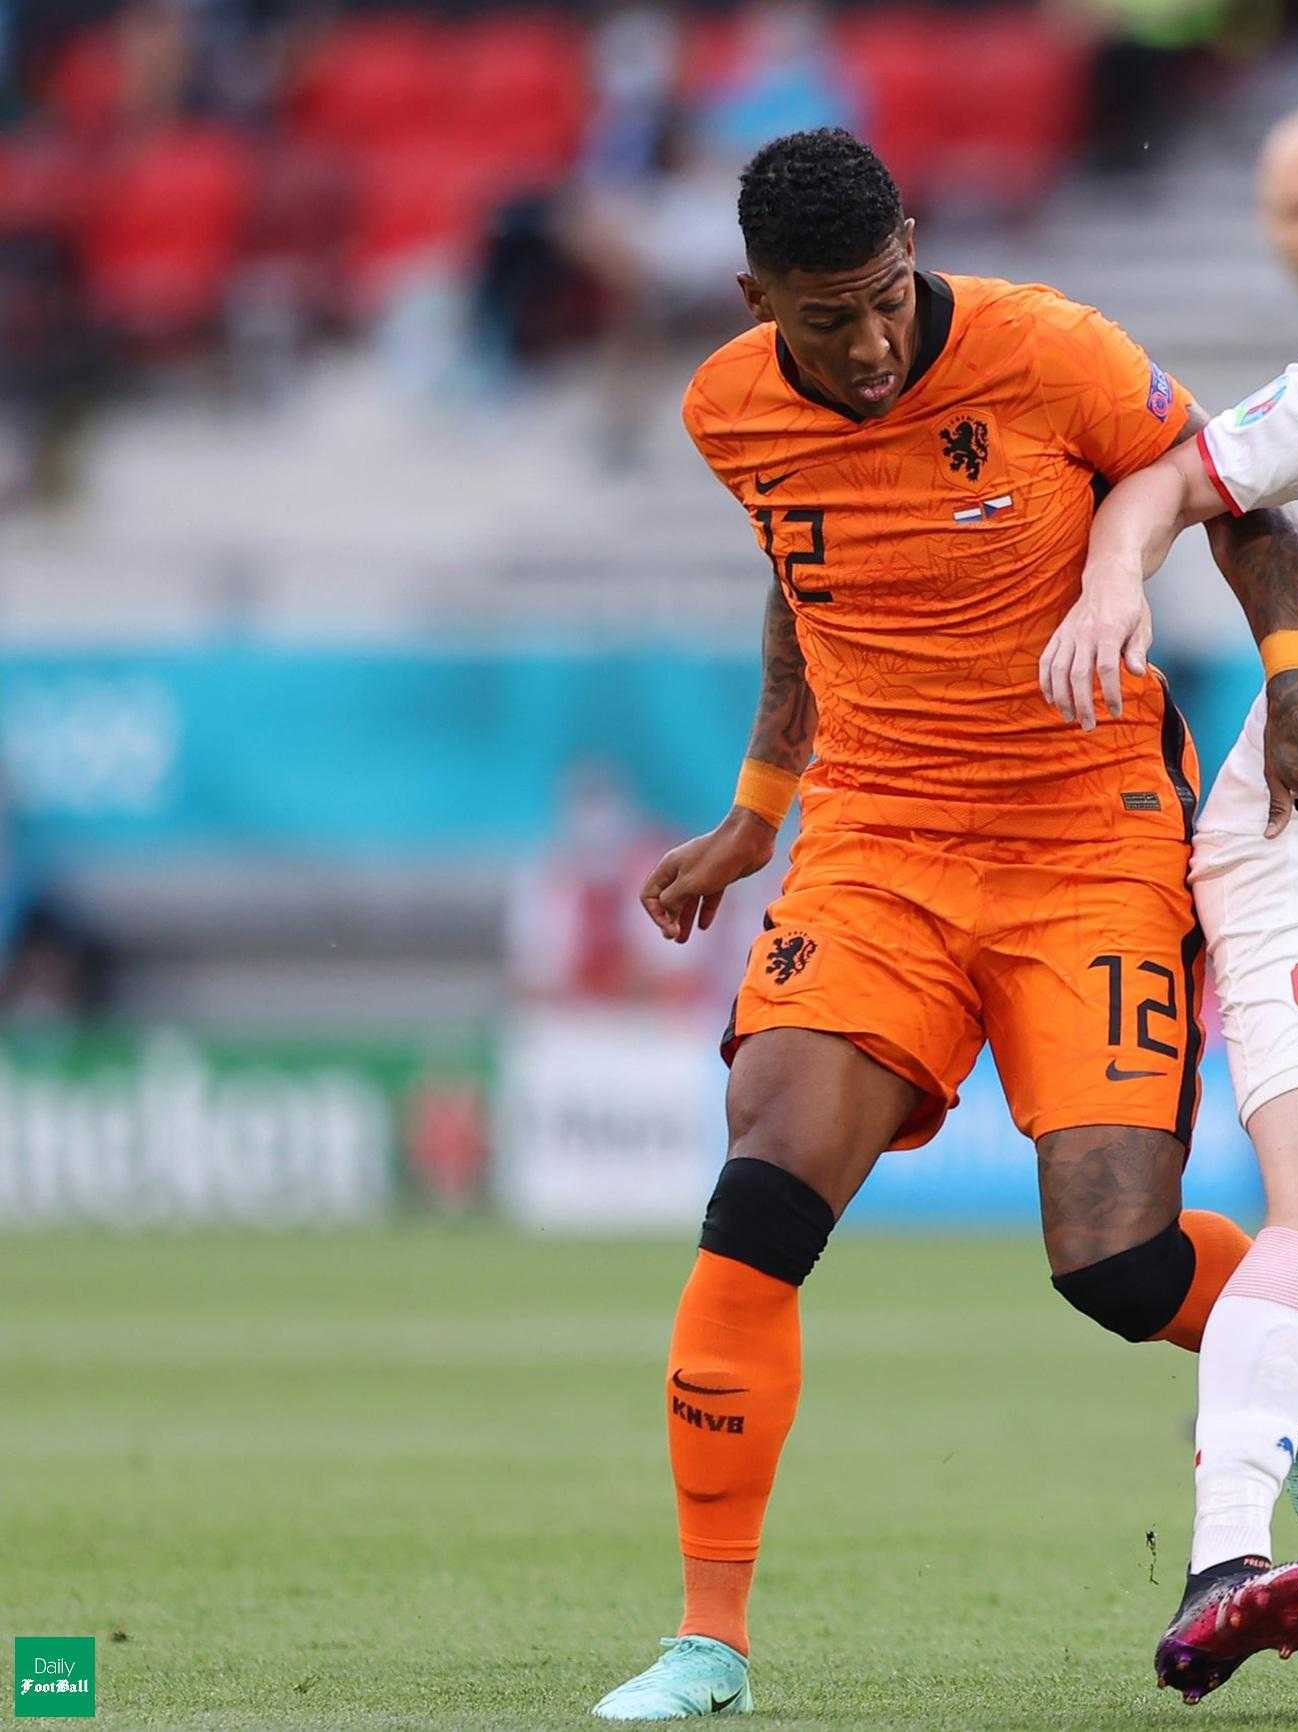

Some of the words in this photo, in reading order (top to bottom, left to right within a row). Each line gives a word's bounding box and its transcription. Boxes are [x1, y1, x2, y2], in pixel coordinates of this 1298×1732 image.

[752, 509, 834, 603] 12
[1087, 955, 1179, 1061] 12
[672, 1395, 745, 1435] KNVB
